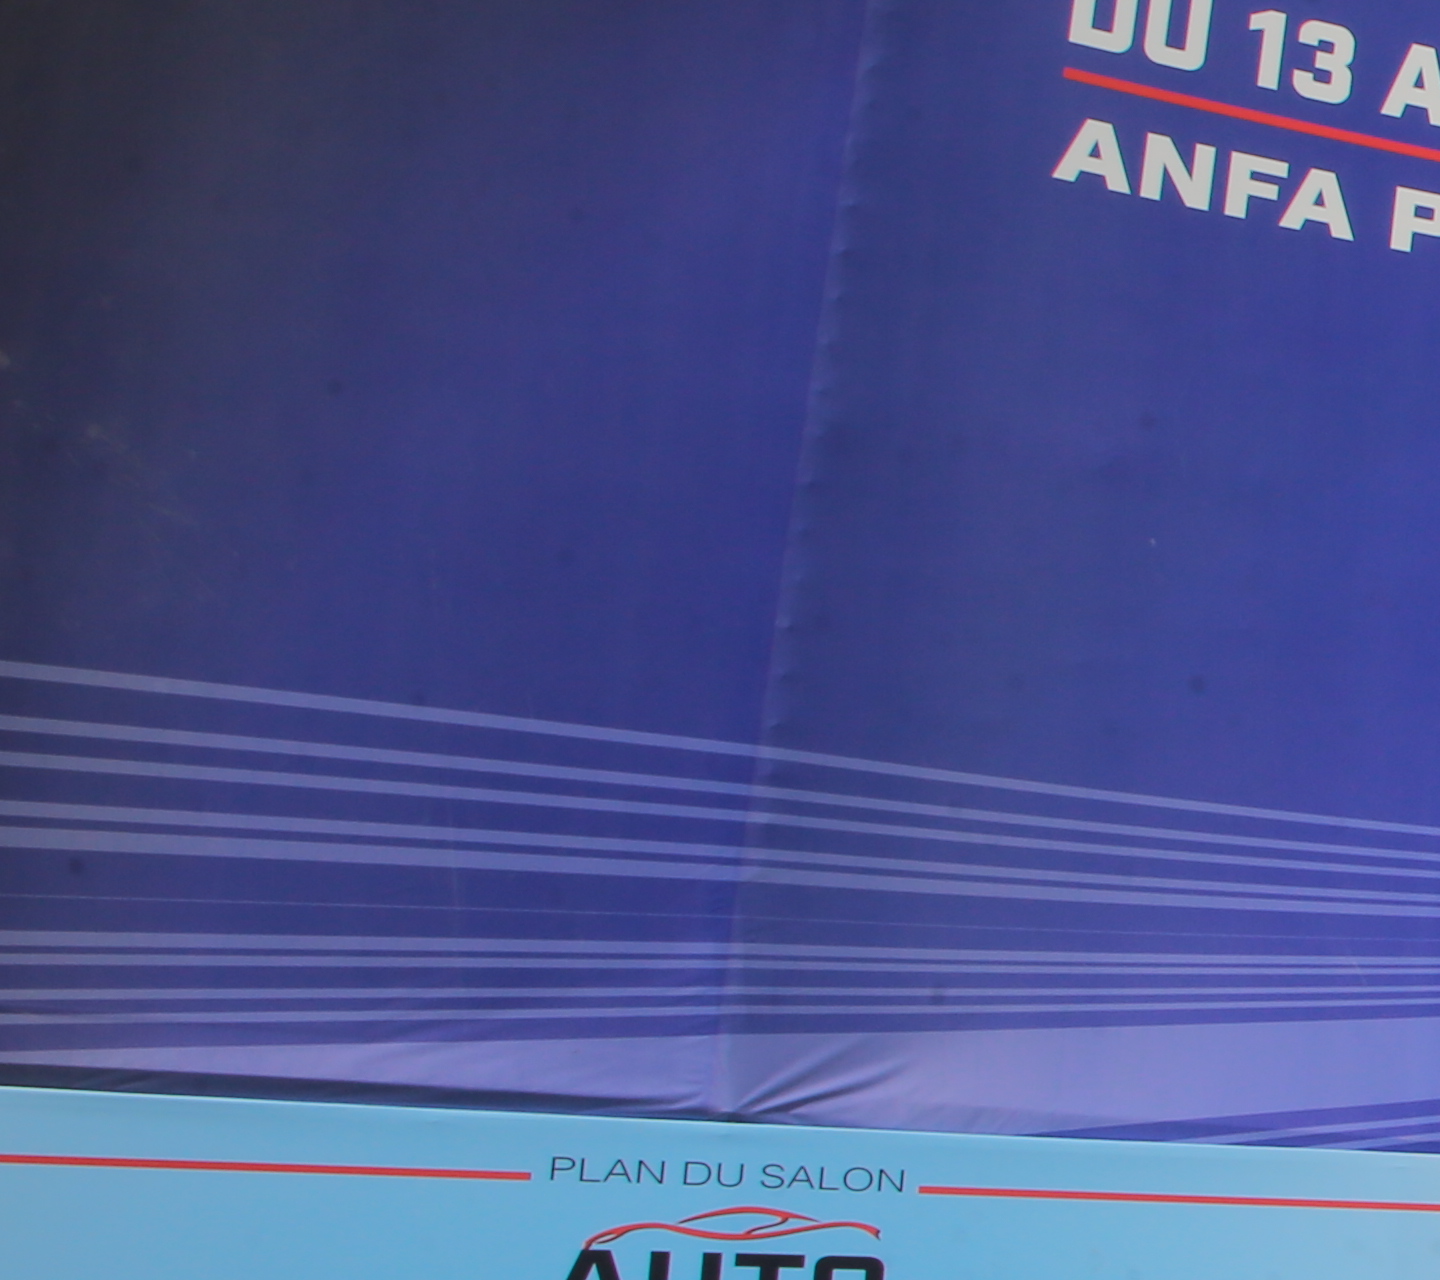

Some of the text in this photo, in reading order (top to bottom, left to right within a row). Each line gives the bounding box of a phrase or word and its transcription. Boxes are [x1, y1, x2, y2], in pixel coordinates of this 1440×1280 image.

[1248, 9, 1356, 106] 13
[1051, 118, 1356, 243] ANFA
[550, 1156, 906, 1193] PLAN DU SALON
